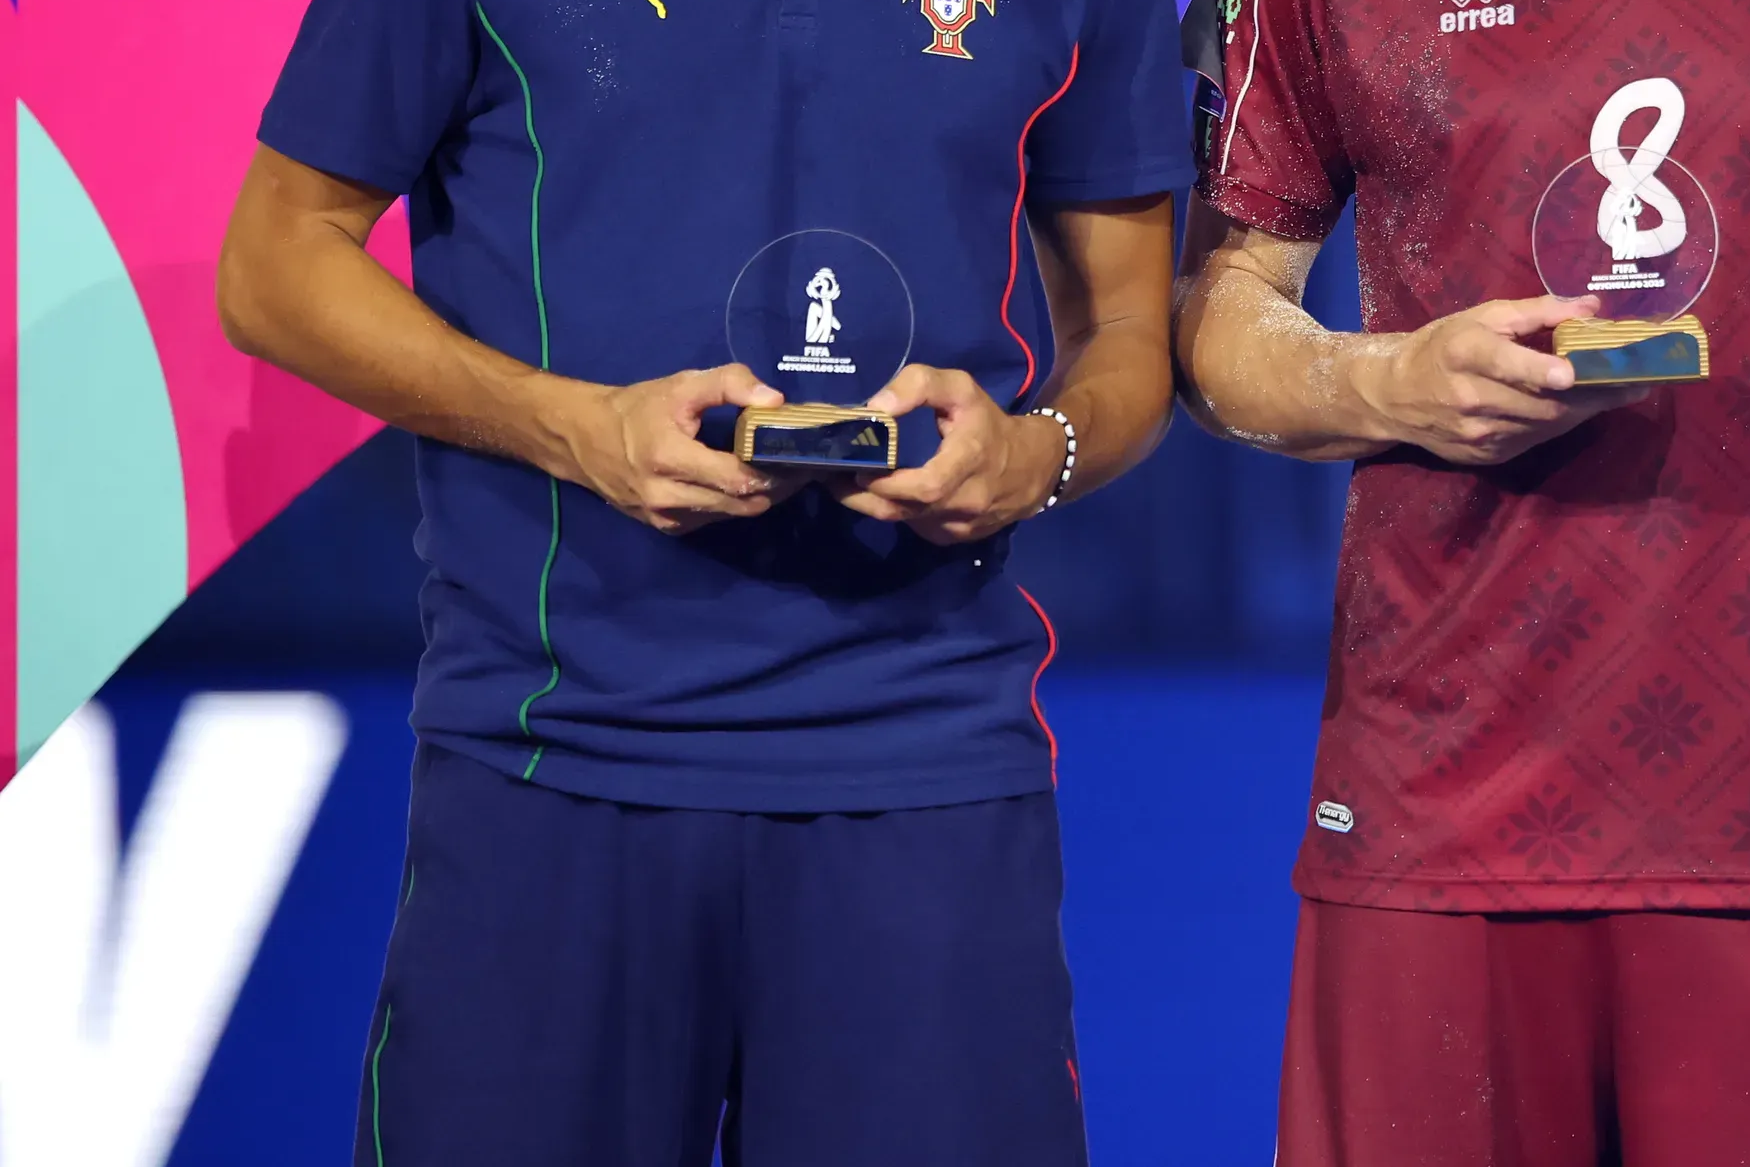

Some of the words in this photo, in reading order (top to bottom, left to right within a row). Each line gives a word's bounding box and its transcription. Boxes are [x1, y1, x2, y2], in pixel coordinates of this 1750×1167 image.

[1589, 77, 1687, 259] 8
[1612, 264, 1638, 274] FIFA
[804, 346, 830, 357] FIFA
